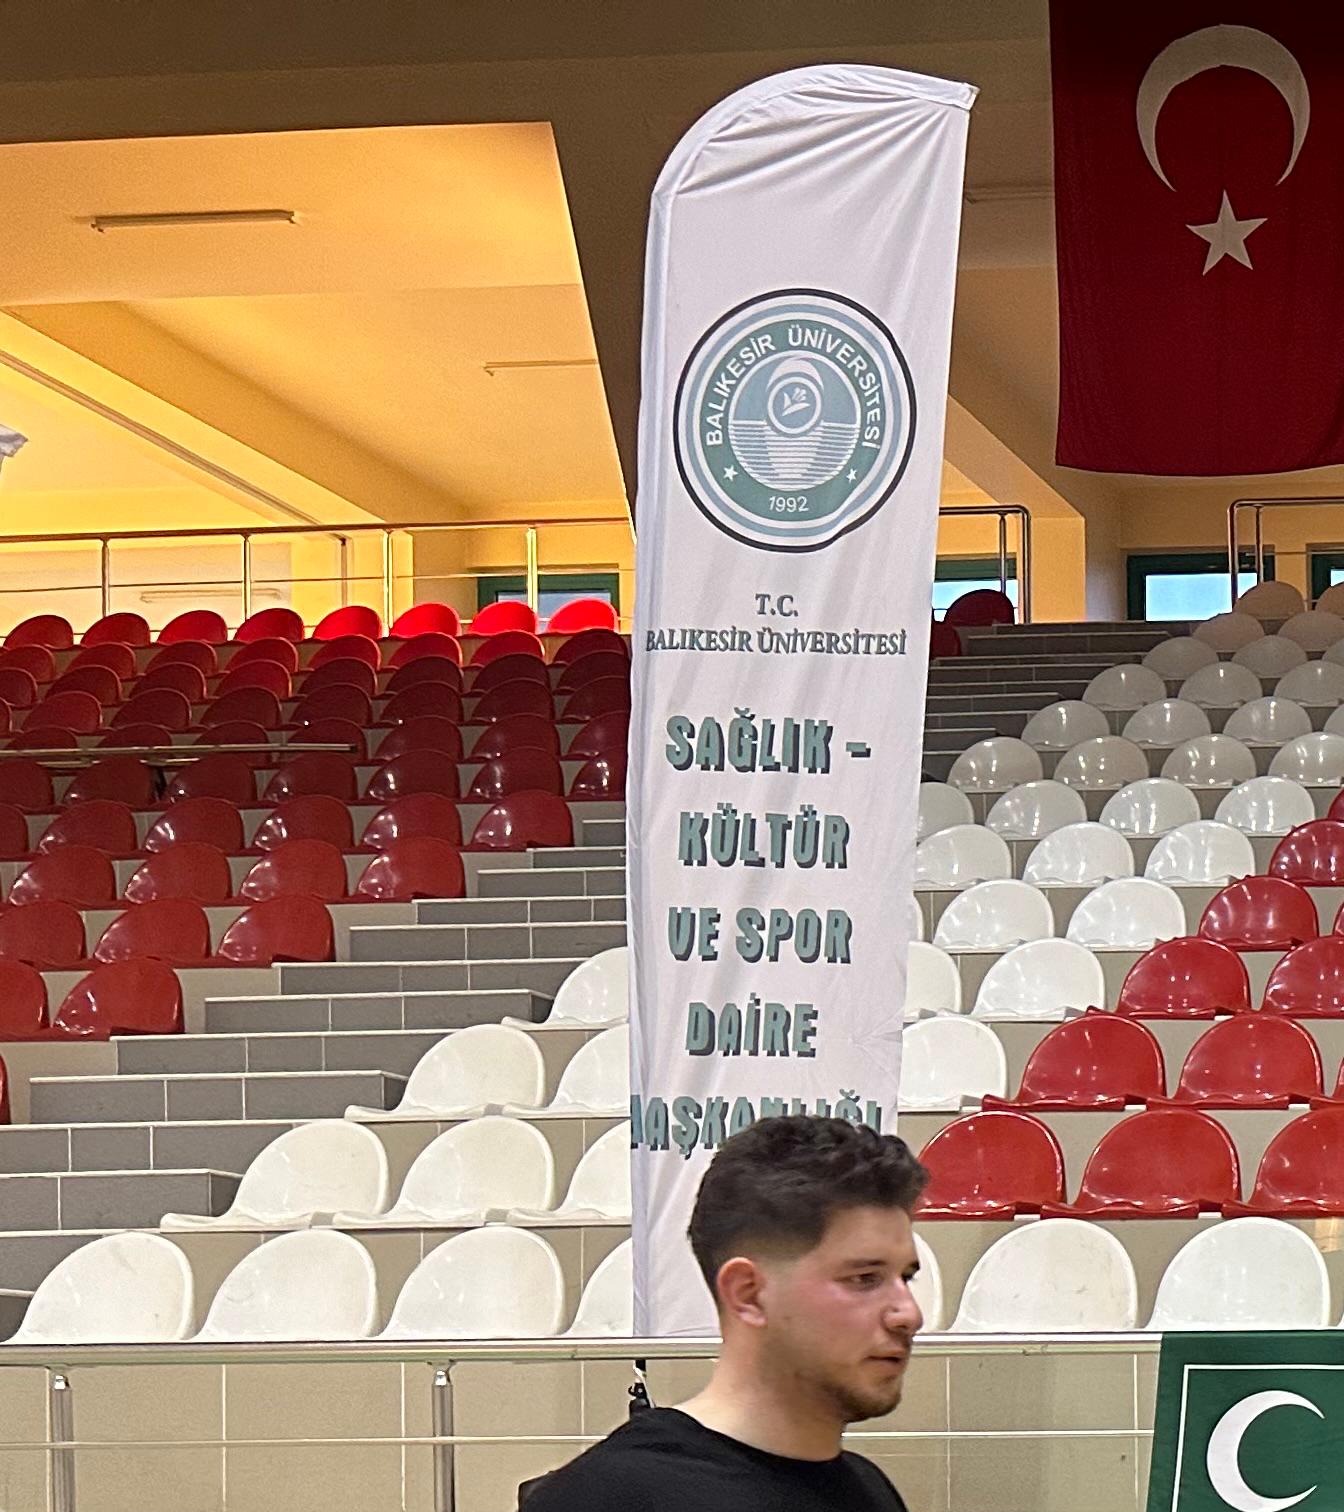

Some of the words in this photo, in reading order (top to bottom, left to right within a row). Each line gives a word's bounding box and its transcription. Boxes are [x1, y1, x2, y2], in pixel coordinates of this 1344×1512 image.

[706, 333, 775, 446] BALIKESİR
[787, 325, 881, 449] ÜNİVERSİTESİ
[768, 496, 809, 512] 1992
[755, 593, 799, 617] T.C.
[645, 625, 754, 653] BALIKESİR
[756, 626, 907, 656] ÜNİVERSİTESİ
[665, 708, 834, 774] SAĞLIK
[678, 803, 850, 870] KÜLTÜR
[667, 907, 721, 963] VE
[735, 907, 853, 965] SPOR
[685, 992, 818, 1058] DAİRE
